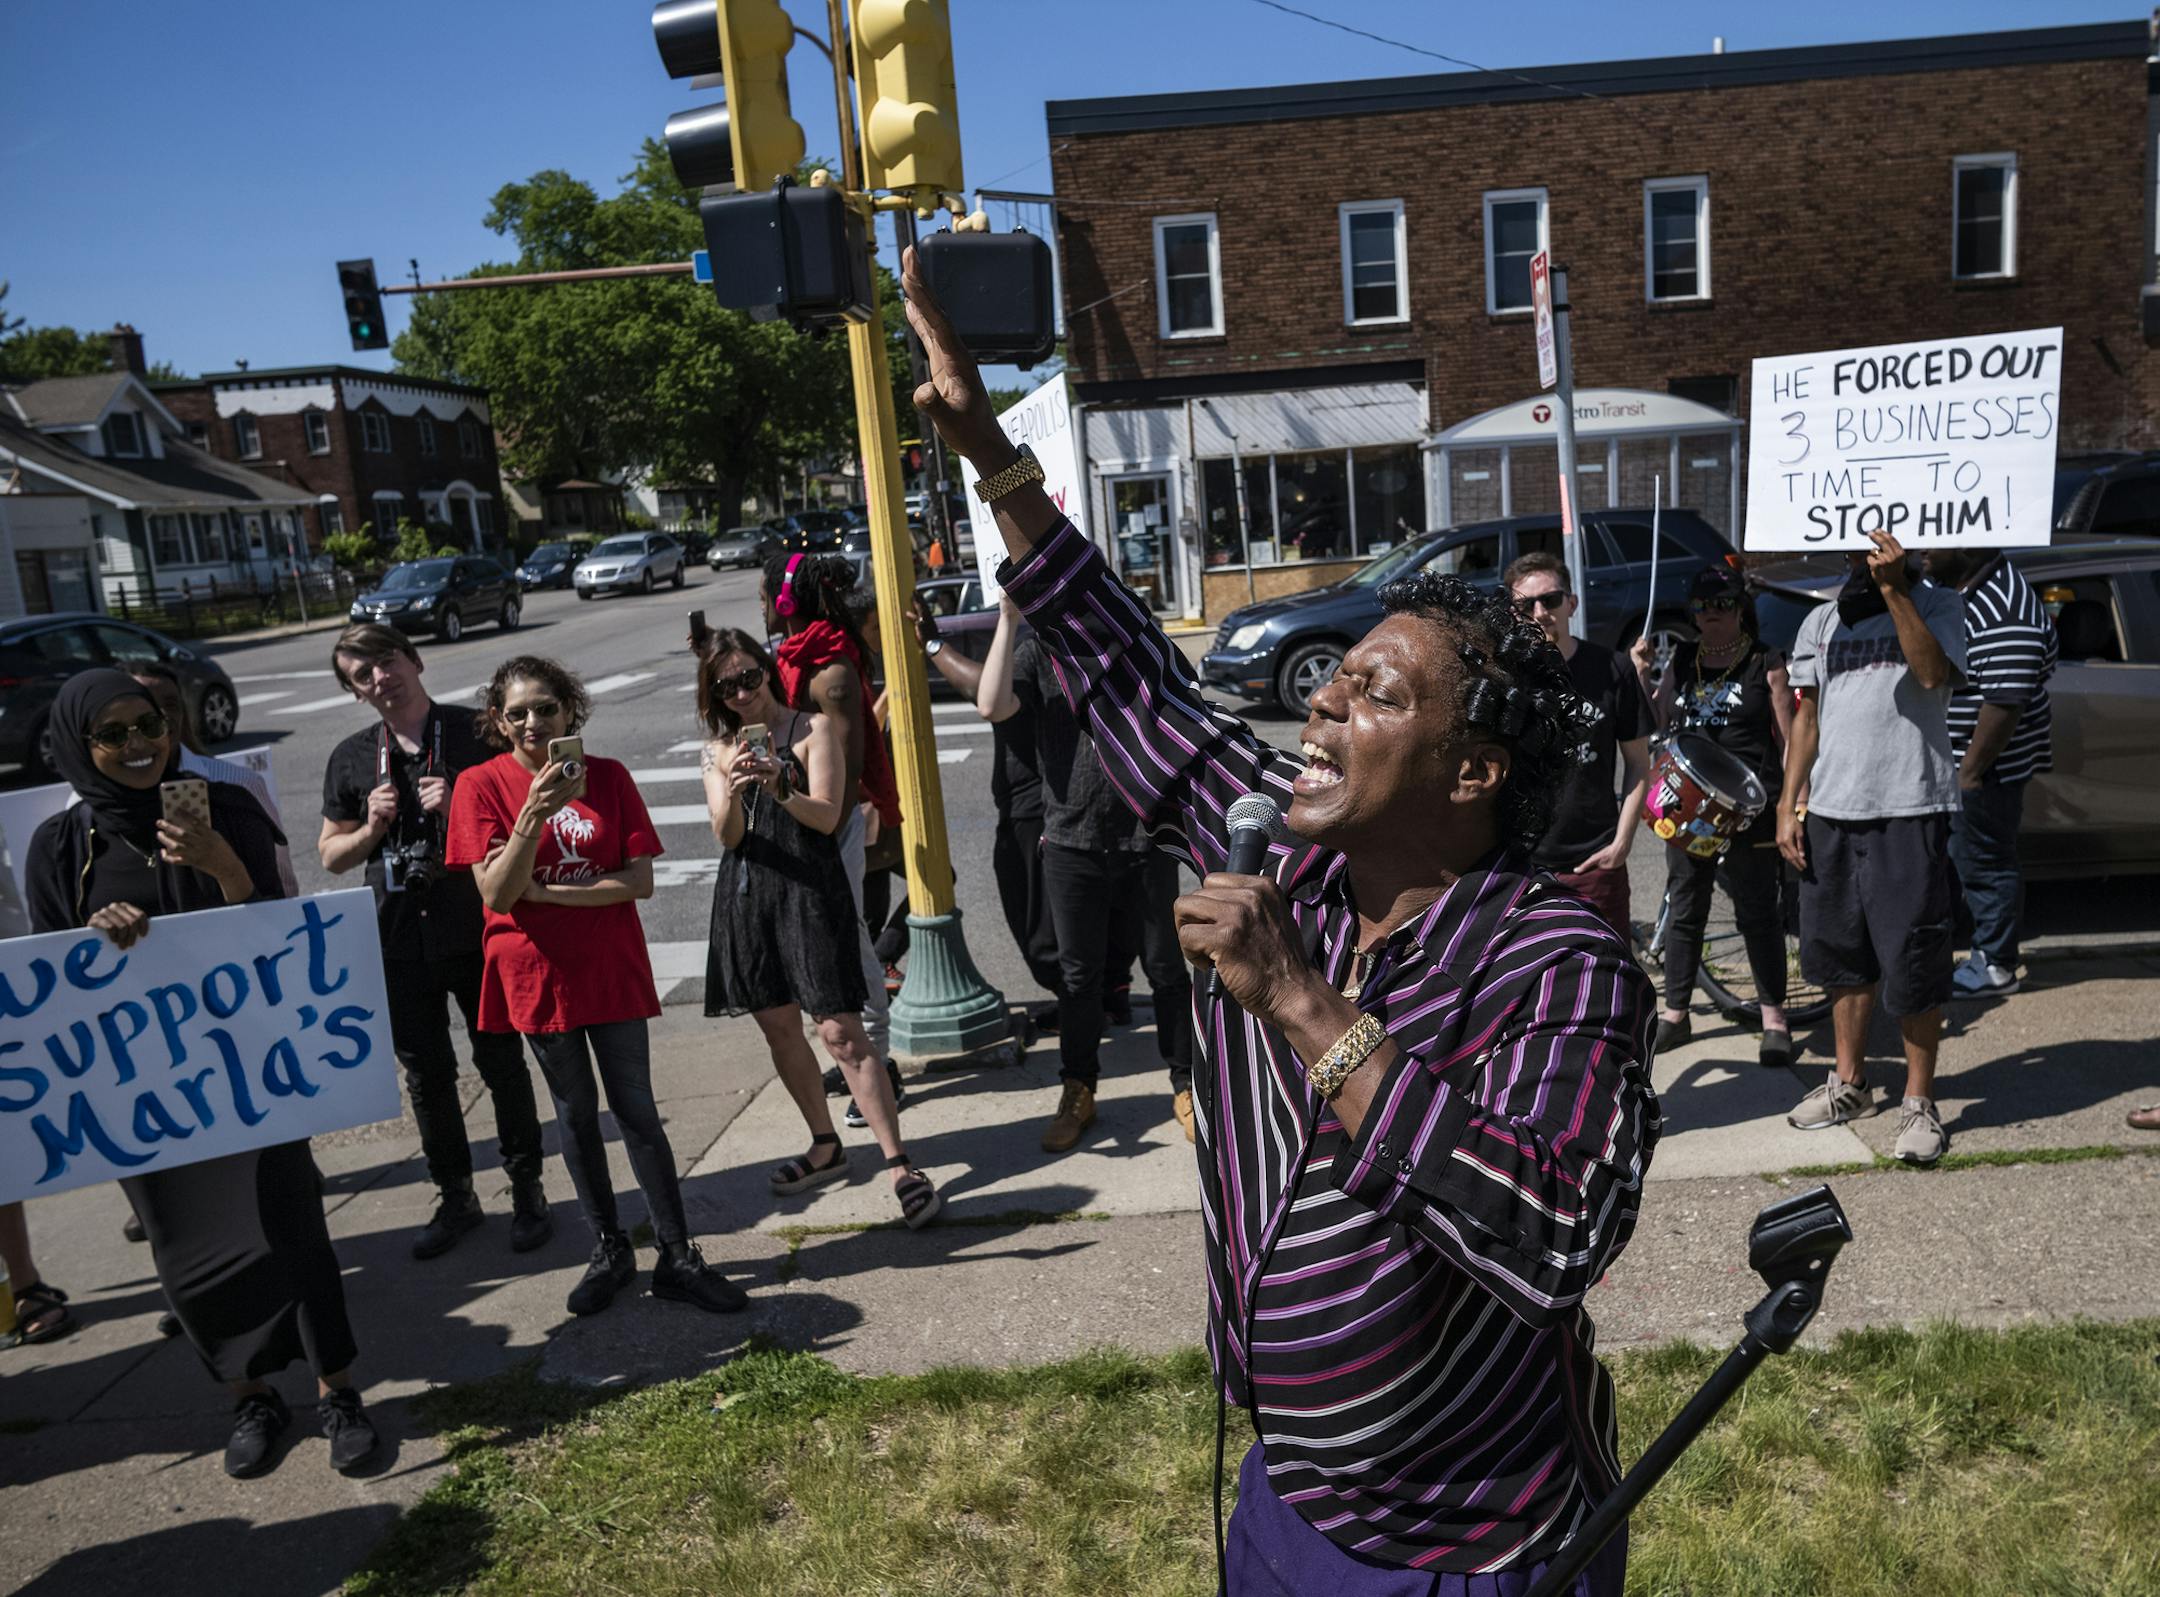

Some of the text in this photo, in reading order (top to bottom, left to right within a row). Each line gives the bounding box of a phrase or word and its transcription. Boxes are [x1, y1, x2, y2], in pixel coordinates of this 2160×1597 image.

[1773, 345, 2057, 403] HE FORCED OUT
[1004, 390, 1066, 444] EAPOLIS
[1599, 400, 1647, 418] Transit
[1778, 392, 2056, 464] 3 BUSINESSES
[1781, 460, 1982, 502] TIME TO
[1804, 501, 1910, 542] STOP
[31, 1005, 375, 1186] Marla's
